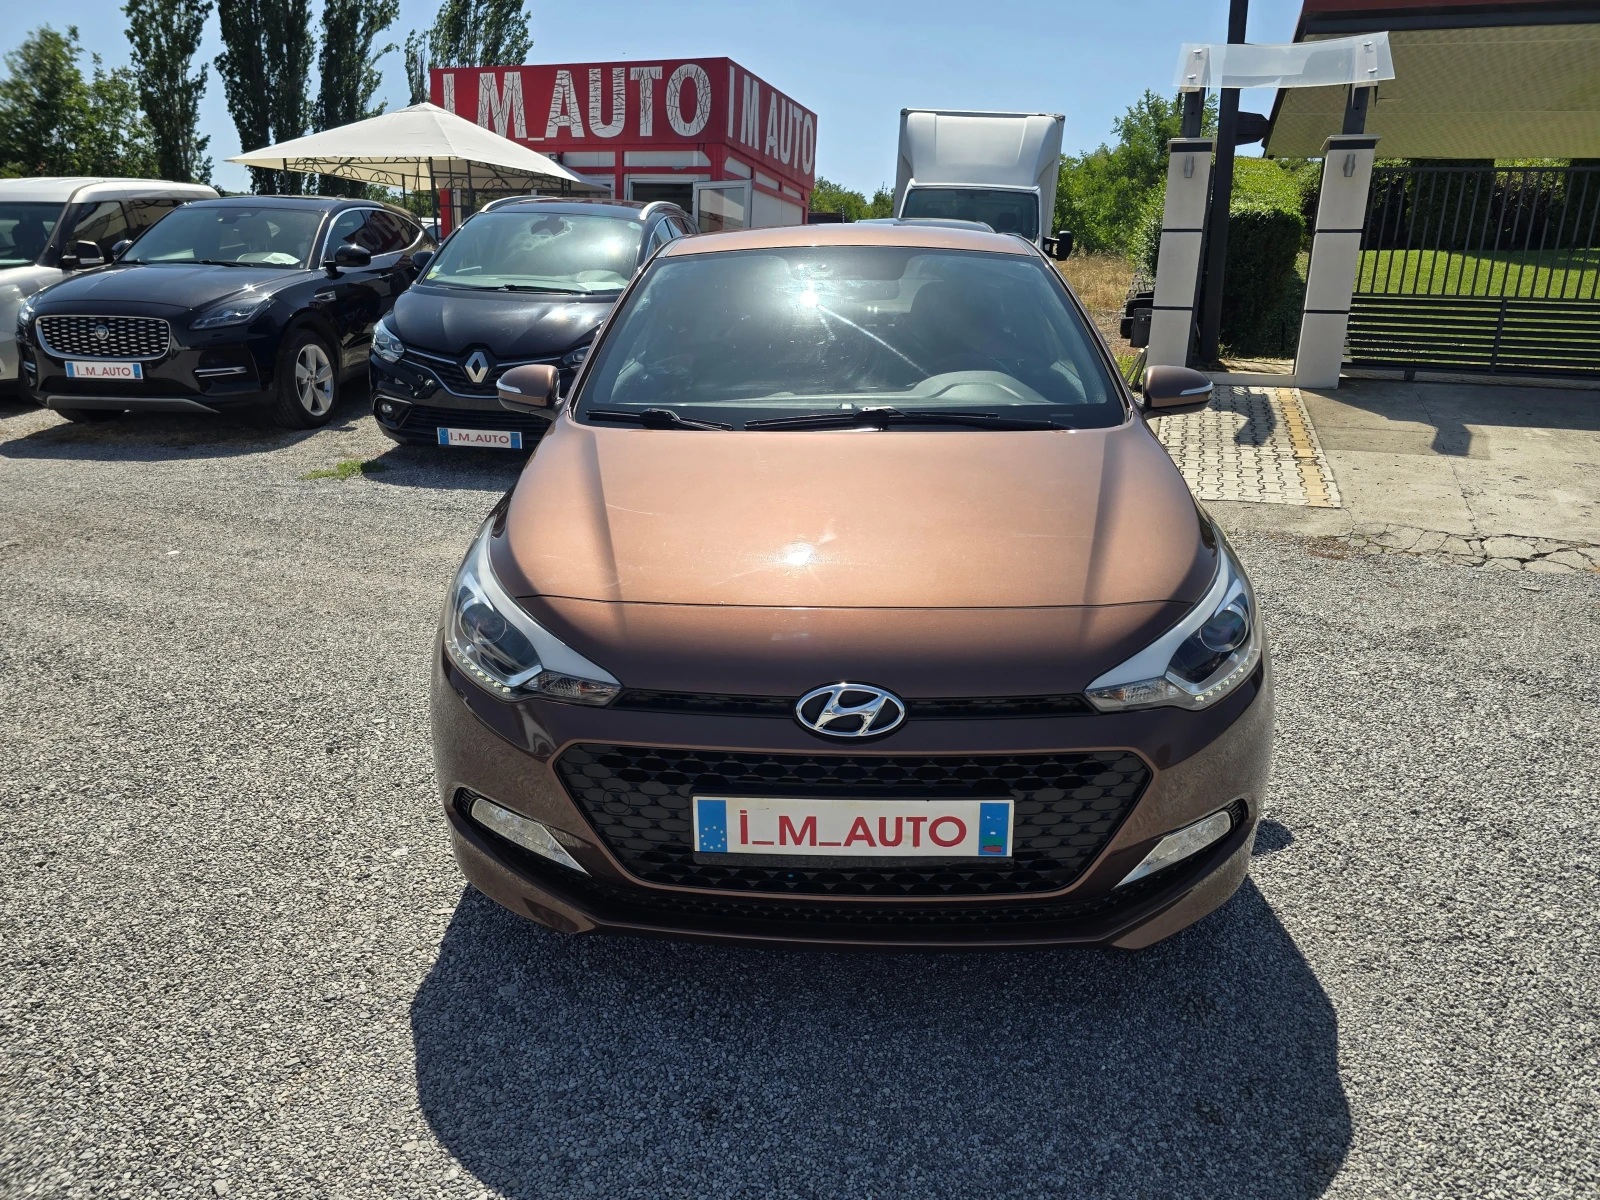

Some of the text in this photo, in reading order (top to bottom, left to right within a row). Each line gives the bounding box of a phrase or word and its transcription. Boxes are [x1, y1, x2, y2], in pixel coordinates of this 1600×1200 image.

[727, 65, 814, 175] I M AUTO
